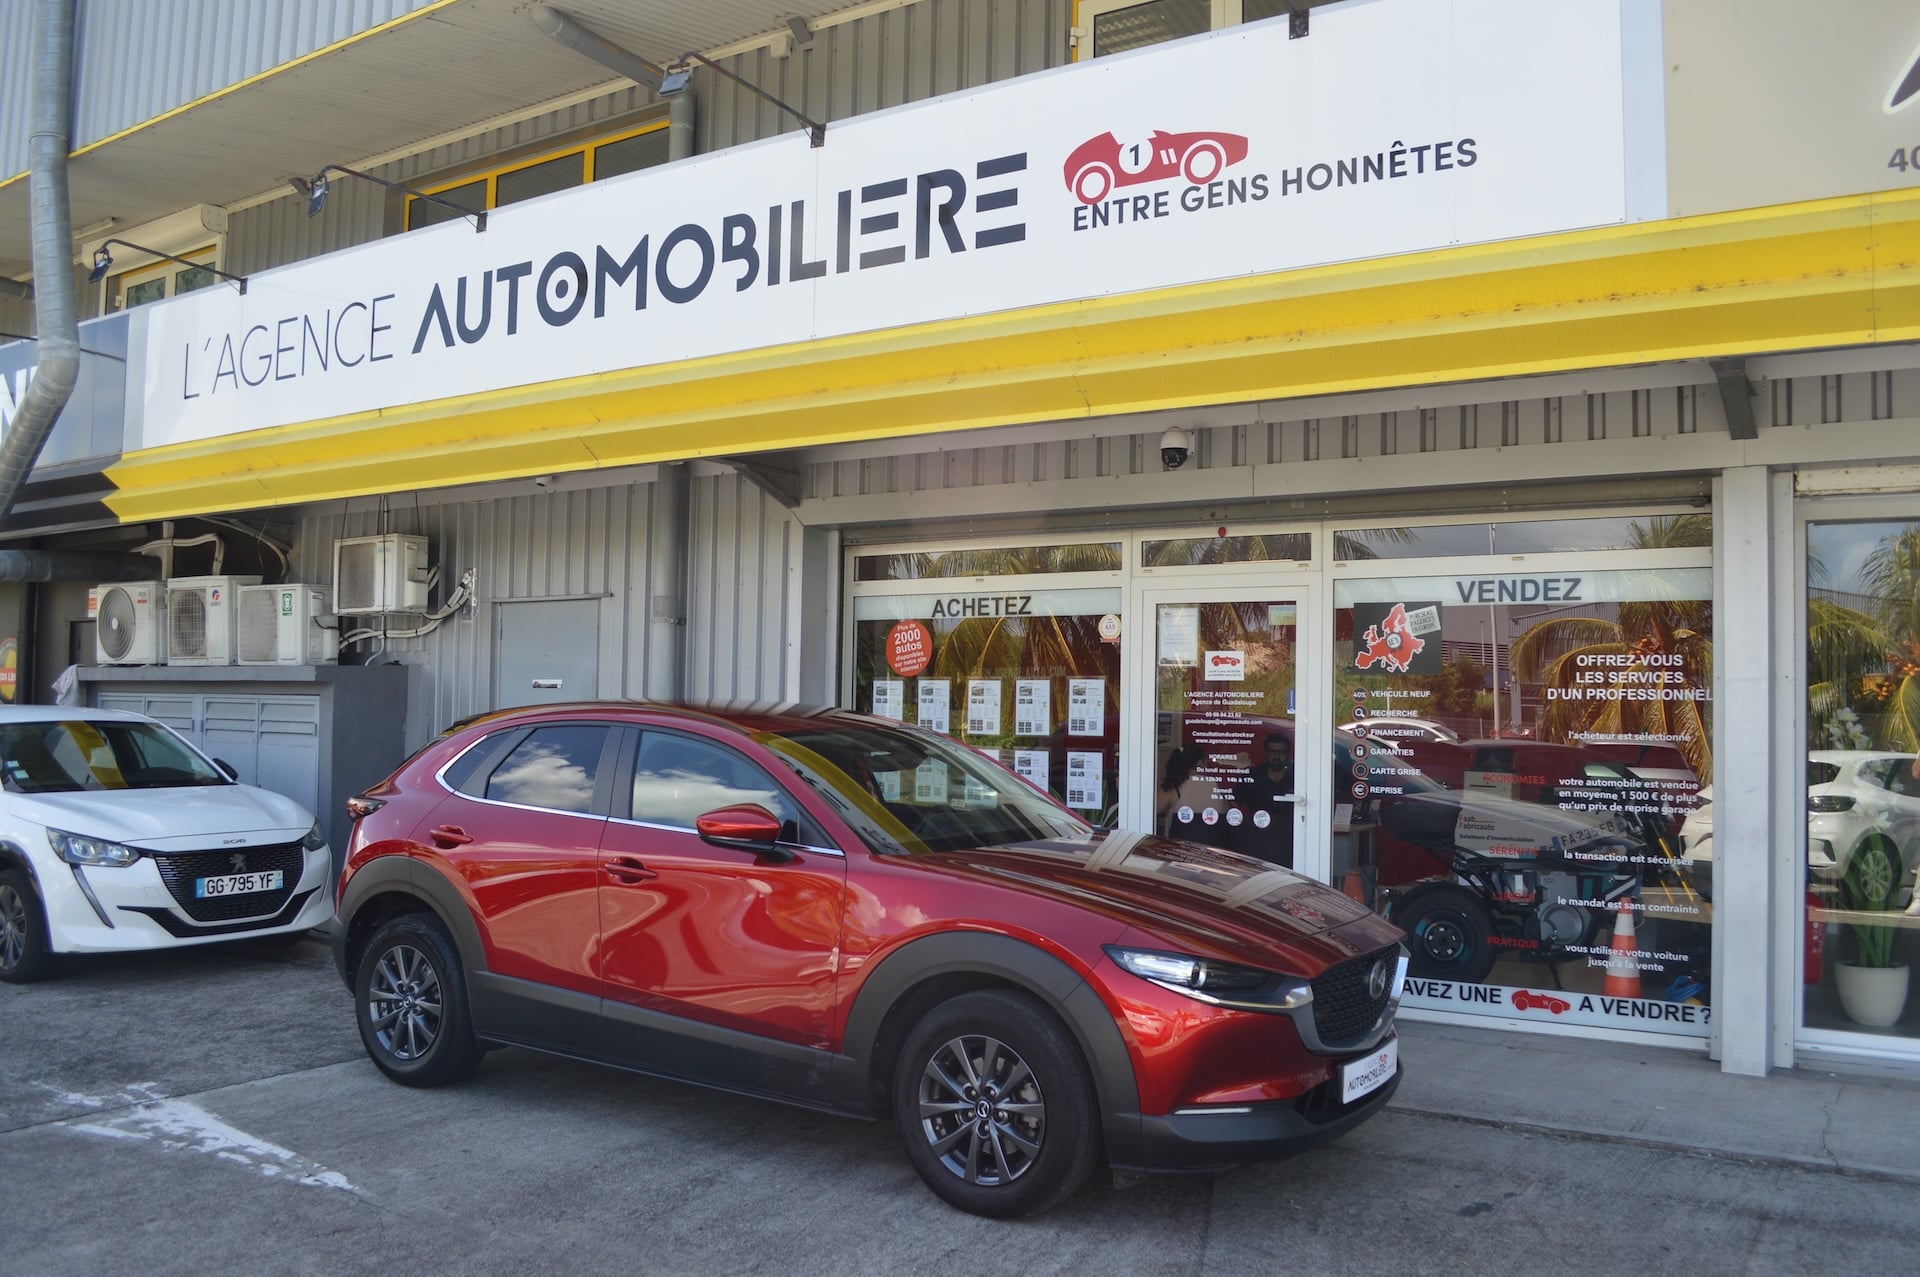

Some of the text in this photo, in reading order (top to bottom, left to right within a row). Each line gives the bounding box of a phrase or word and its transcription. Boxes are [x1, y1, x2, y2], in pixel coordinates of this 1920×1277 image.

[1129, 144, 1140, 166] 1
[1073, 137, 1478, 231] ENTRE GENS HONNÊTES
[184, 152, 1027, 399] L'AGENCE AUTOMOBILIERE
[0, 366, 39, 443] N
[1457, 578, 1581, 602] VENDEZ
[932, 596, 1032, 617] ACHETEZ
[894, 629, 921, 645] 2000
[896, 642, 922, 654] autos
[1577, 654, 1683, 667] OFFREZ-VOUS
[1576, 672, 1684, 684] LES SERVICES
[1370, 690, 1431, 698] VEHICULE NEUF
[1547, 688, 1713, 701] D'UN PROFESSIONNEL
[1370, 729, 1425, 737] FINANCEMENT
[1568, 731, 1693, 742] l'acheteur est sélectionné
[1370, 748, 1415, 756] GARANTIES
[1397, 768, 1422, 776] GRISE
[1559, 778, 1699, 790] votre automobile est vendue
[1574, 791, 1618, 800] moyenne
[1630, 792, 1649, 800] 500
[1652, 792, 1658, 800] €
[1660, 792, 1673, 801] de
[1676, 793, 1697, 803] plus
[1559, 803, 1697, 815] qu'un prix de reprise garage
[1459, 822, 1495, 831] Fabricauto
[1489, 843, 1540, 857] SÉRÉNITÉ
[1564, 850, 1694, 866] la transaction est sécurisée
[1558, 896, 1699, 914] le mandat est sans contrainte
[1488, 936, 1539, 949] PRATIQUE
[1565, 945, 1688, 962] vous utilisez votre voiture
[1588, 957, 1664, 972] jusqu'à la vente
[1402, 978, 1712, 1025] AVEZ UNE A VENDRE ?
